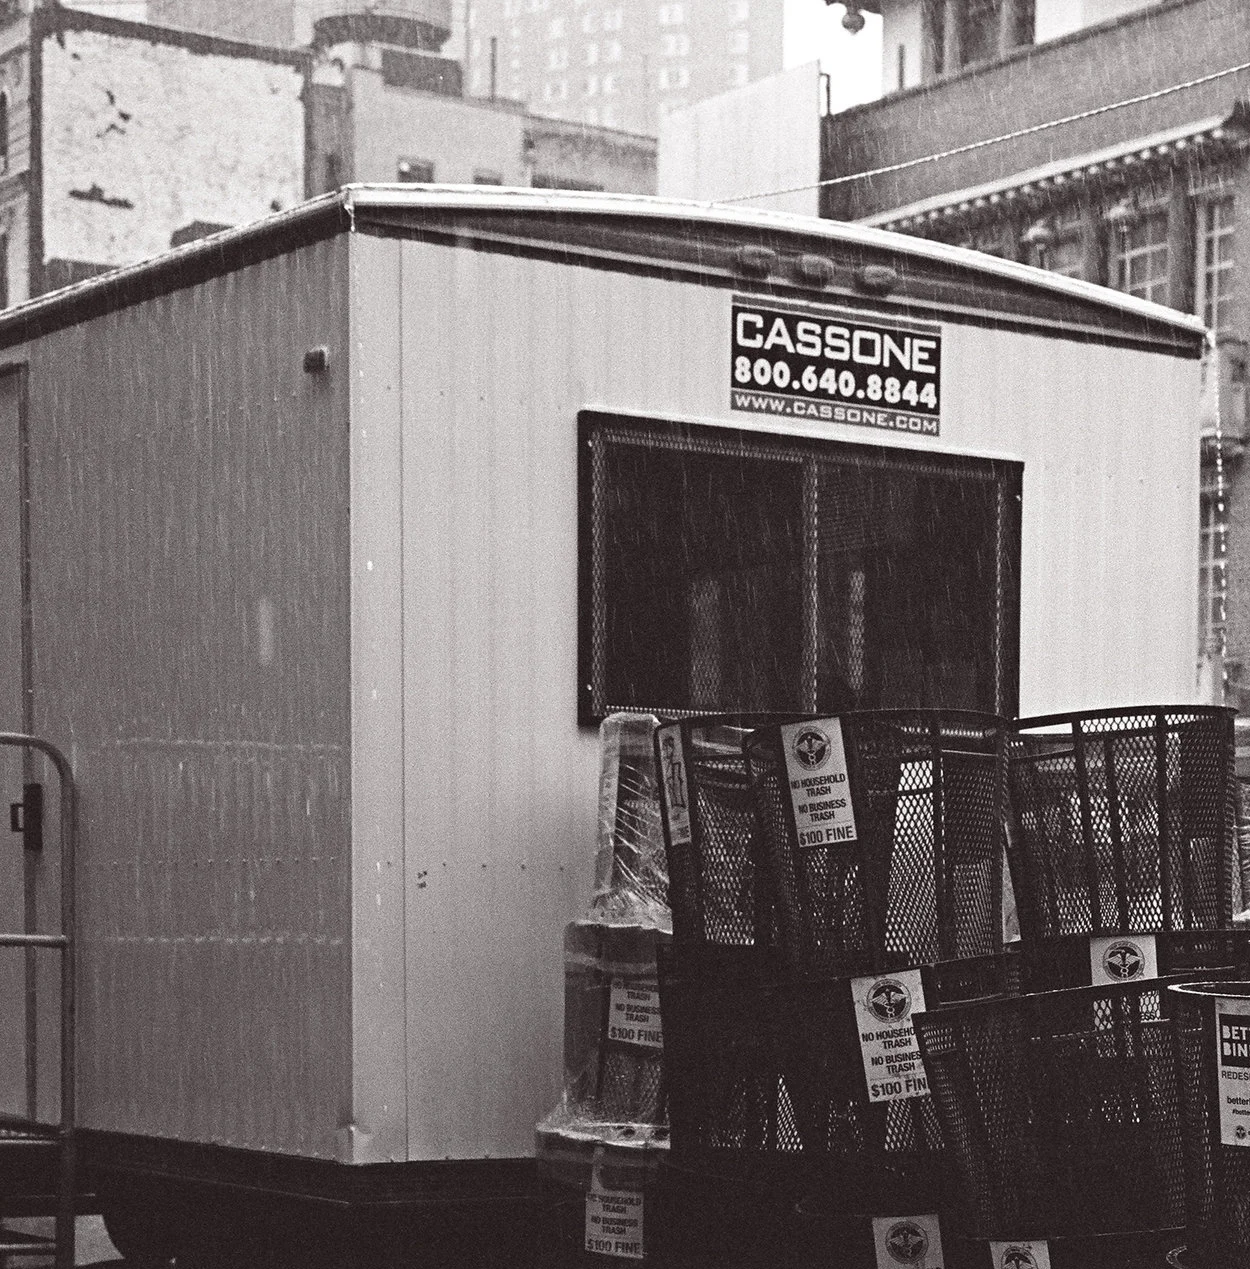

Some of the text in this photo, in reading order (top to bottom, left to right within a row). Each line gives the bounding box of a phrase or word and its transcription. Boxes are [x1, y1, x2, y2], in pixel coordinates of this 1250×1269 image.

[737, 312, 936, 374] CASSONE
[735, 356, 937, 409] 800.640.8844
[735, 394, 938, 433] WWW.CASSONE.COM
[791, 773, 846, 789] NO HOUSEHOLD
[806, 786, 832, 797] TRASH
[798, 799, 847, 814] NO BUSINESS
[810, 811, 835, 822] TRASH
[800, 825, 853, 846] $100 FINE
[611, 1027, 662, 1042] $100 FINE
[862, 1026, 915, 1043] NO HOUSEHO
[882, 1037, 912, 1049] TRASH
[1223, 1042, 1248, 1057] BIN
[871, 1051, 923, 1066] NO BUSINES
[886, 1062, 915, 1073] TRASH
[871, 1077, 927, 1098] $100 FIN
